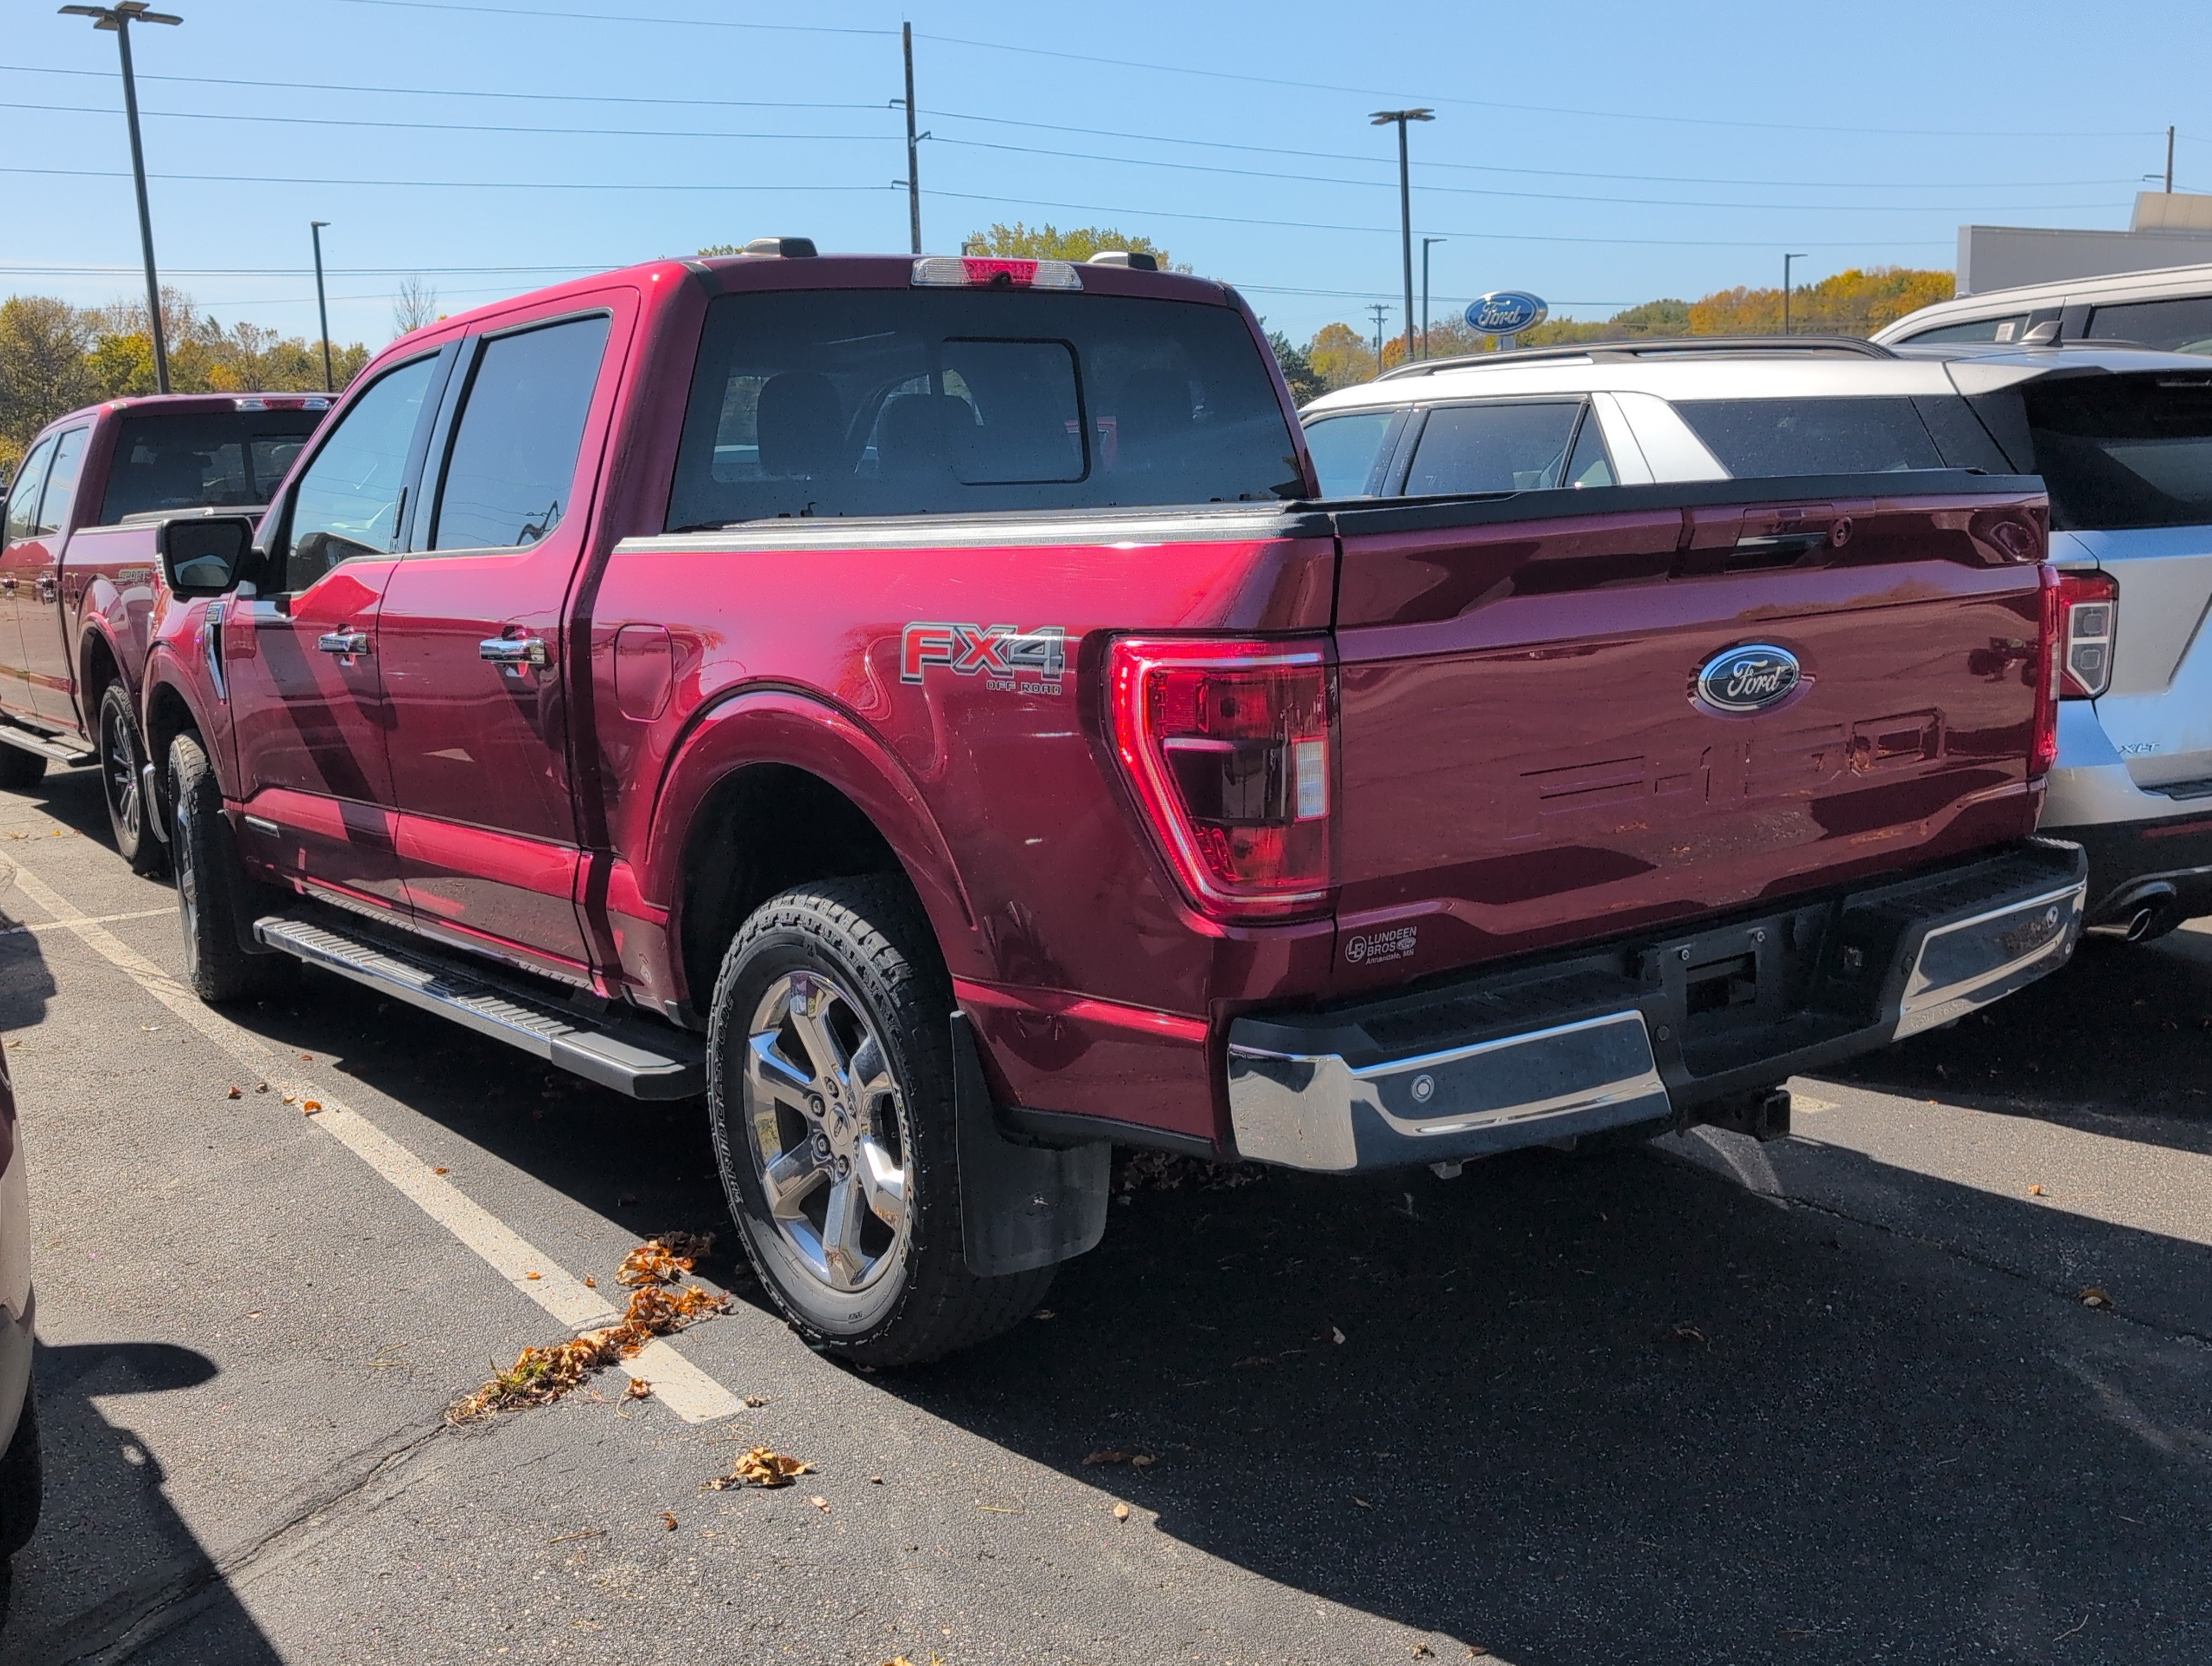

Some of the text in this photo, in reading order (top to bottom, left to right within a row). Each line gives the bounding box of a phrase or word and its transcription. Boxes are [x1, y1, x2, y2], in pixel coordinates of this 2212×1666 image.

[1478, 300, 1521, 326] Ford
[900, 621, 1065, 684] FX4
[986, 679, 1063, 695] OFF ROAD
[1727, 659, 1781, 697] Ford
[1368, 926, 1417, 945] LUNDEEN
[1367, 941, 1396, 957] BROS
